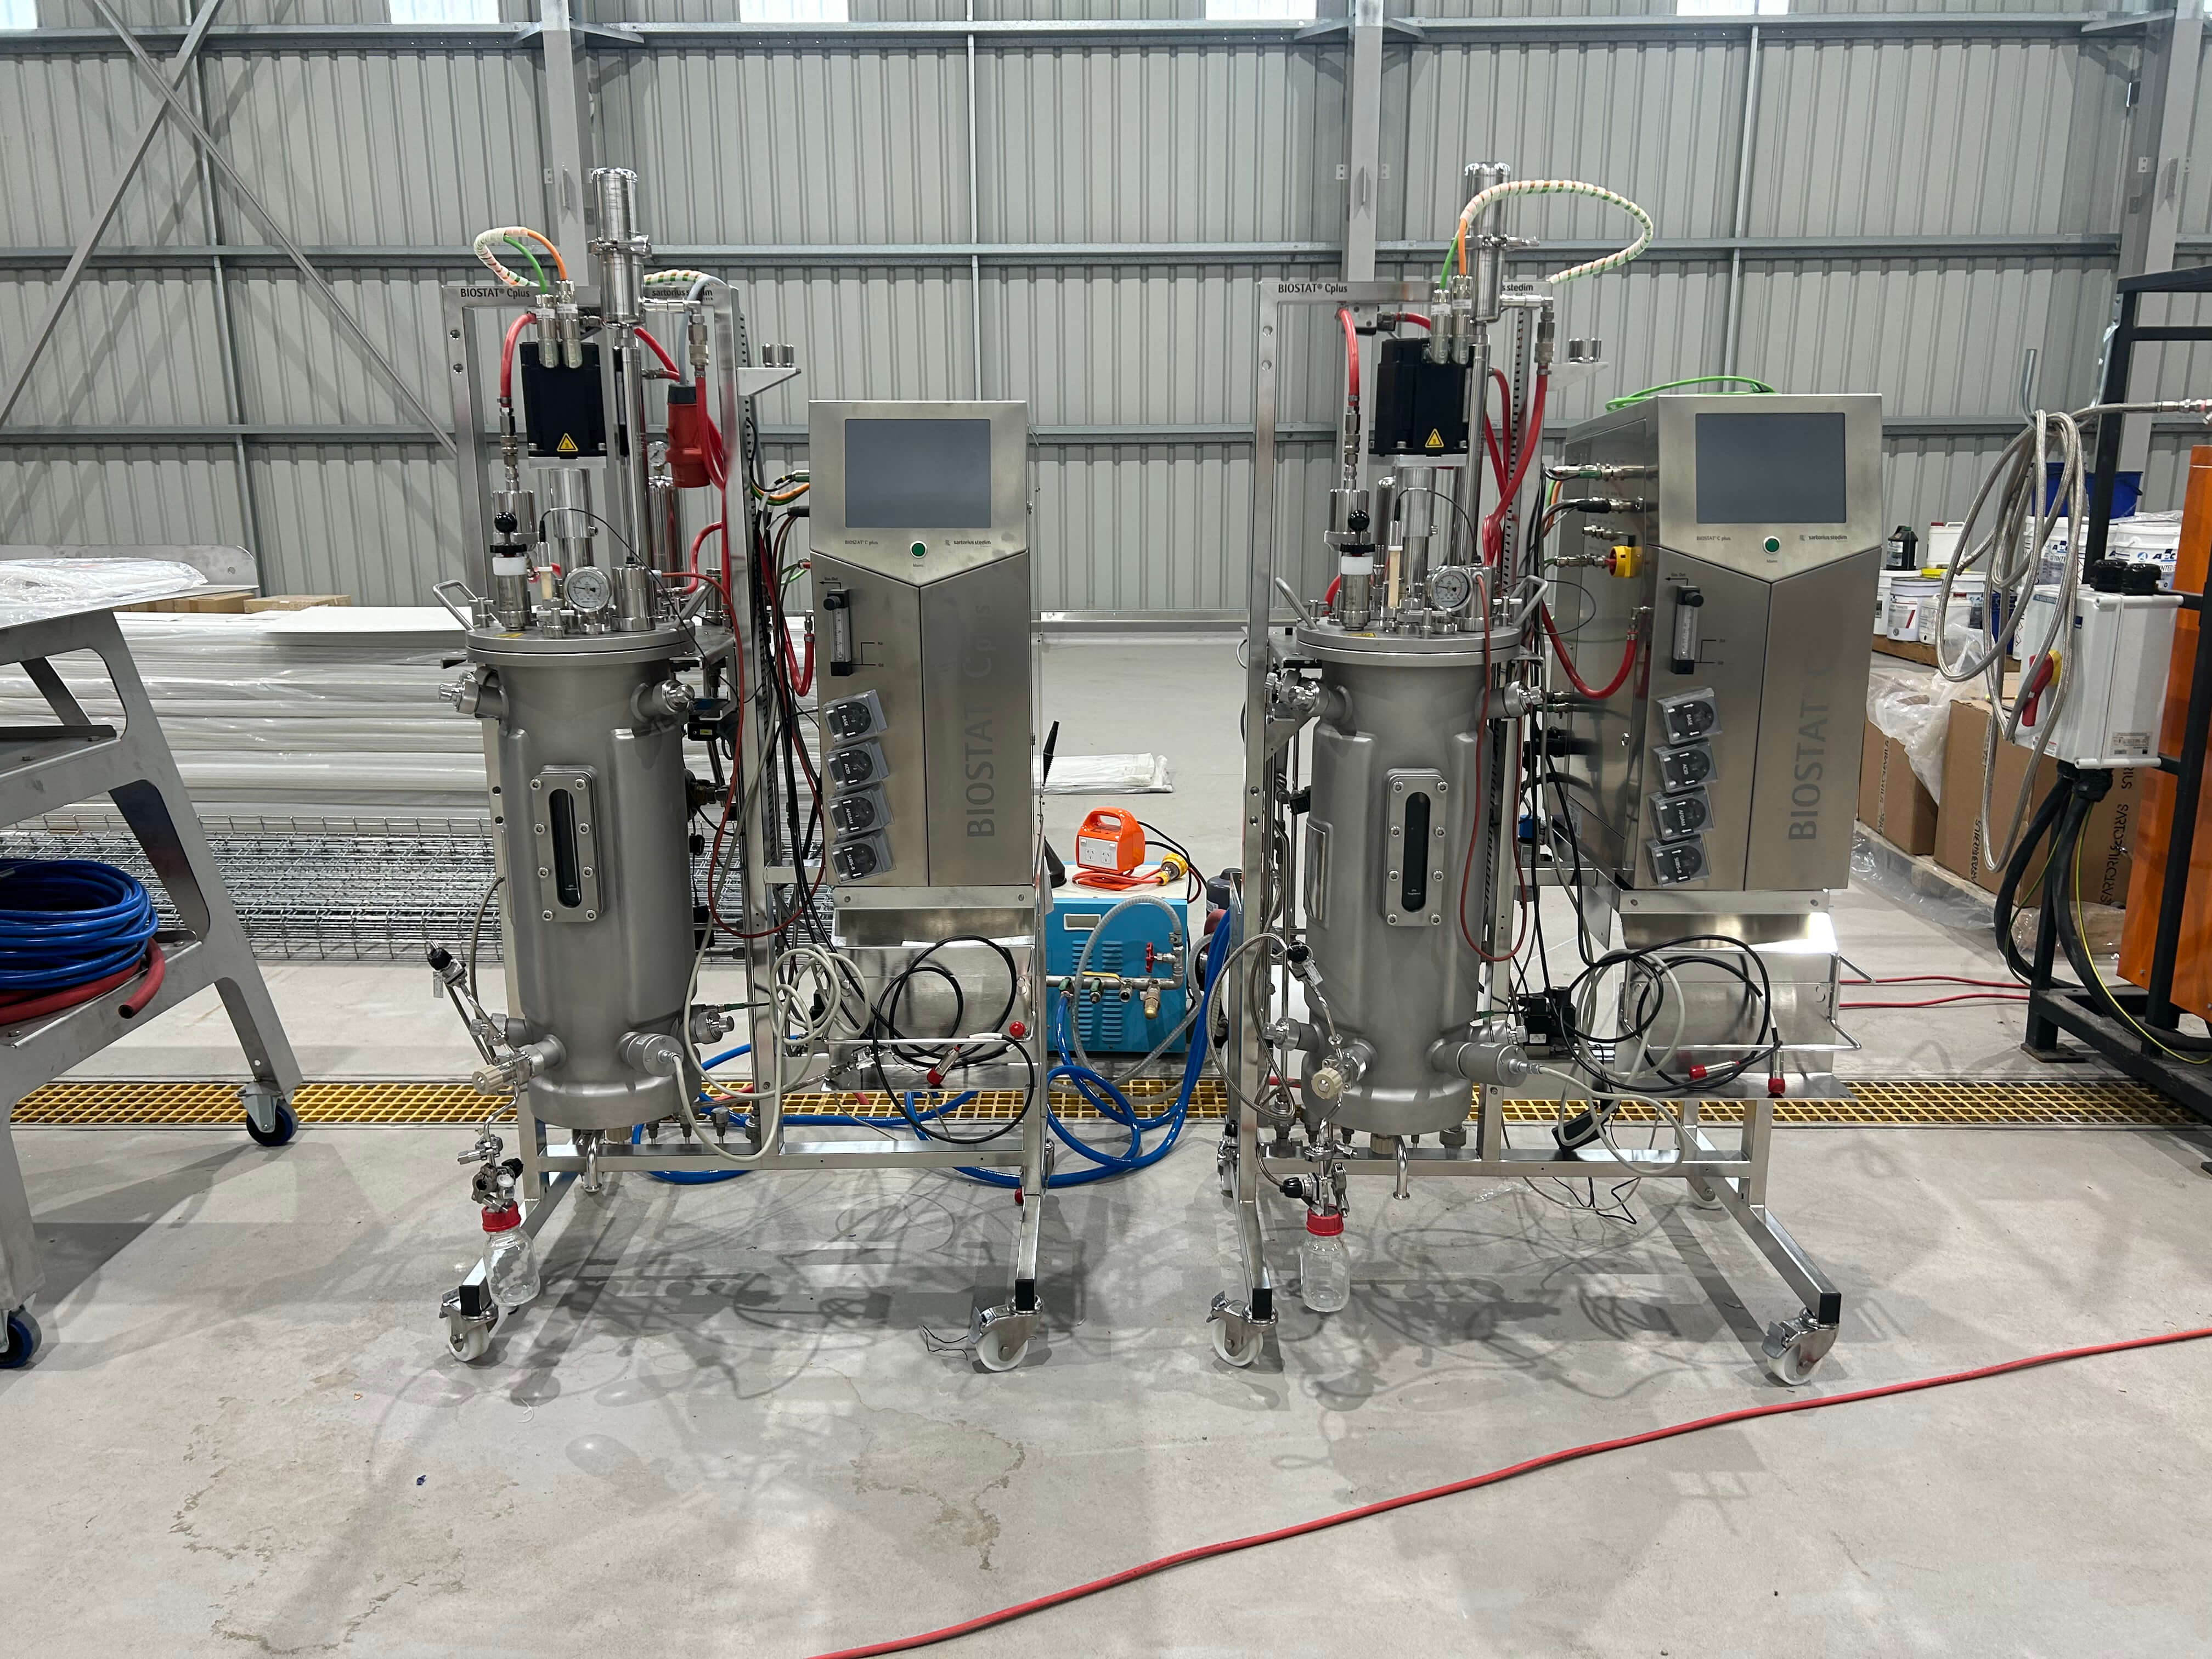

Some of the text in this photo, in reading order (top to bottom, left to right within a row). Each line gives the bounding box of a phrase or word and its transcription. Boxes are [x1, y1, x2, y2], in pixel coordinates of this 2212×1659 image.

[1325, 283, 1348, 295] Cplus
[1506, 283, 1533, 291] stedim
[507, 288, 530, 299] Cplus
[845, 808, 854, 825] AFOAM
